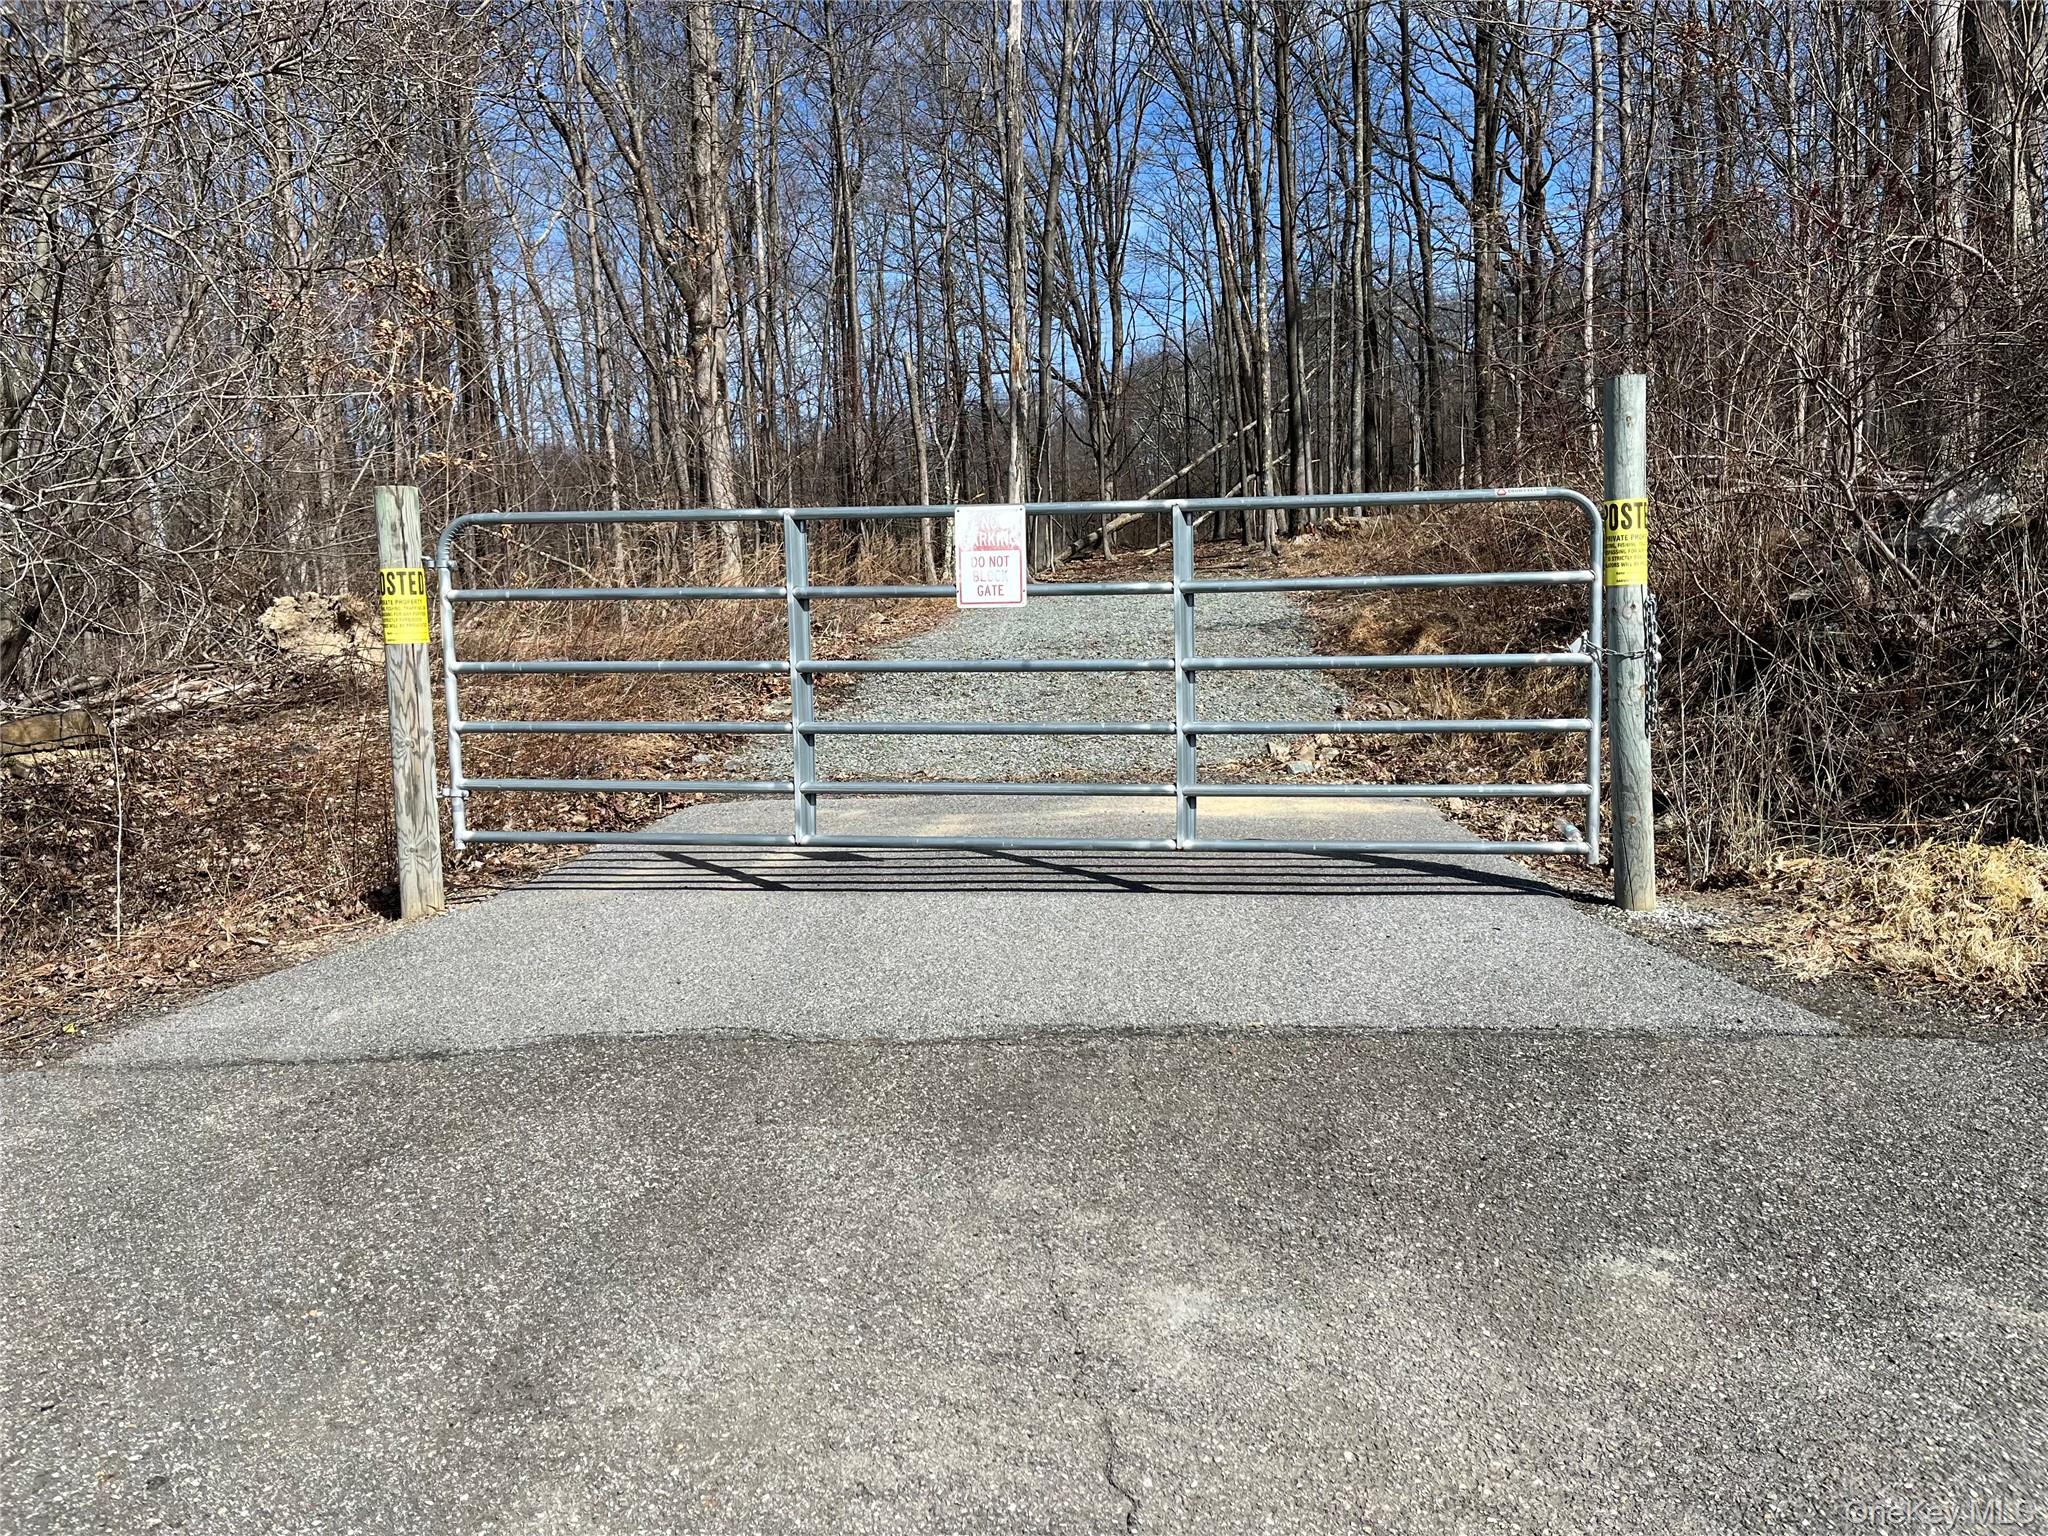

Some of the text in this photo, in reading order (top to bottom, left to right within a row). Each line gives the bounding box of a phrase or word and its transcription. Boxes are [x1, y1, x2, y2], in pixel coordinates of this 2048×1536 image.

[1602, 502, 1648, 531] OST
[966, 530, 1017, 547] ARKIN
[971, 555, 1009, 568] DO NOT
[379, 571, 424, 596] OSTED
[973, 569, 1009, 583] BLOCK
[977, 584, 1005, 597] GATE
